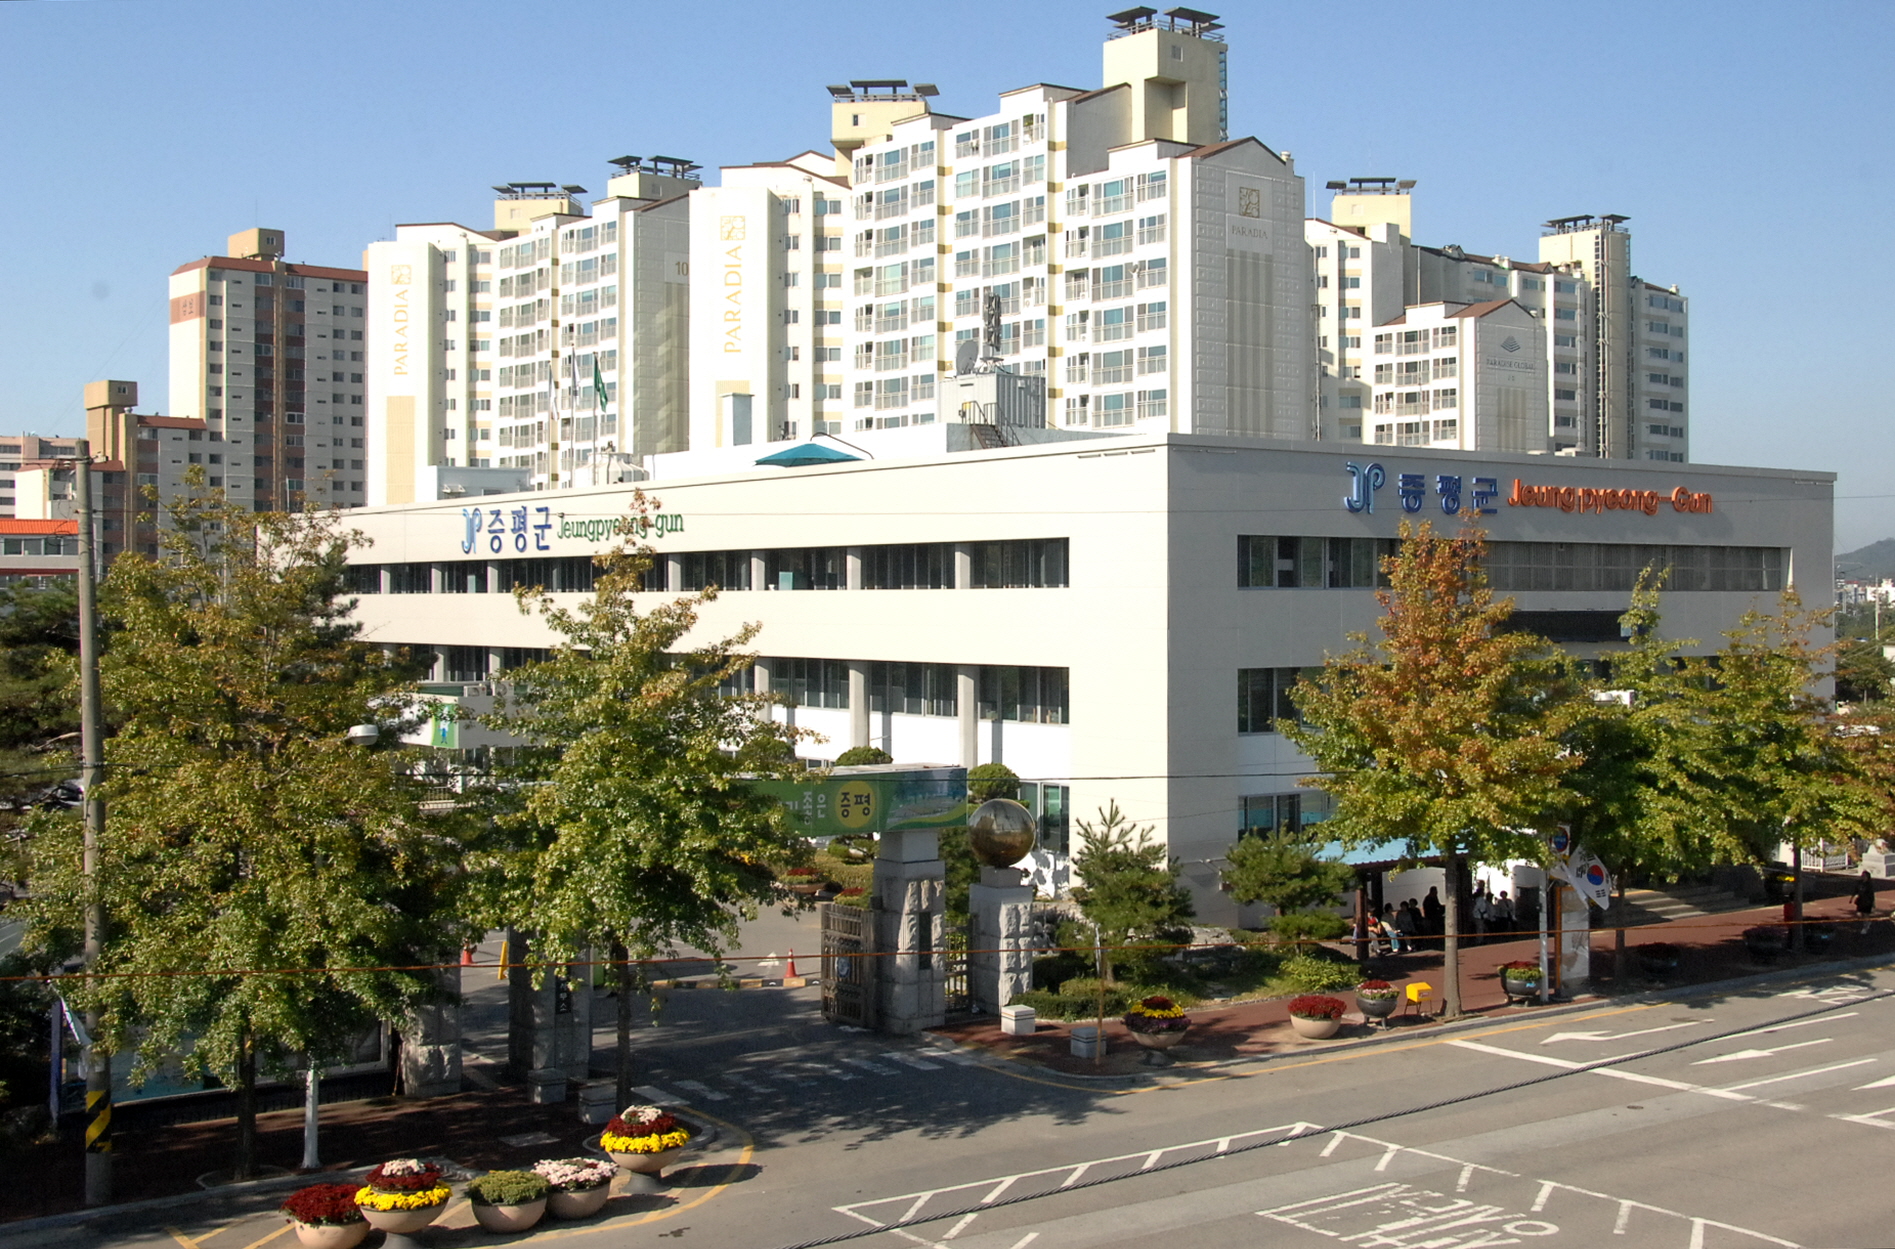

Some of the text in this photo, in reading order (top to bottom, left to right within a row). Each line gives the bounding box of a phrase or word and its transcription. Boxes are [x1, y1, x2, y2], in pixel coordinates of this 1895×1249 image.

[1231, 225, 1268, 239] PARADIA
[723, 245, 742, 353] PARADIA
[394, 289, 409, 375] PARADIA
[1398, 473, 1499, 515] 증평군
[487, 505, 552, 553] 증평군
[803, 791, 827, 826] 좋은
[840, 791, 871, 818] 증평
